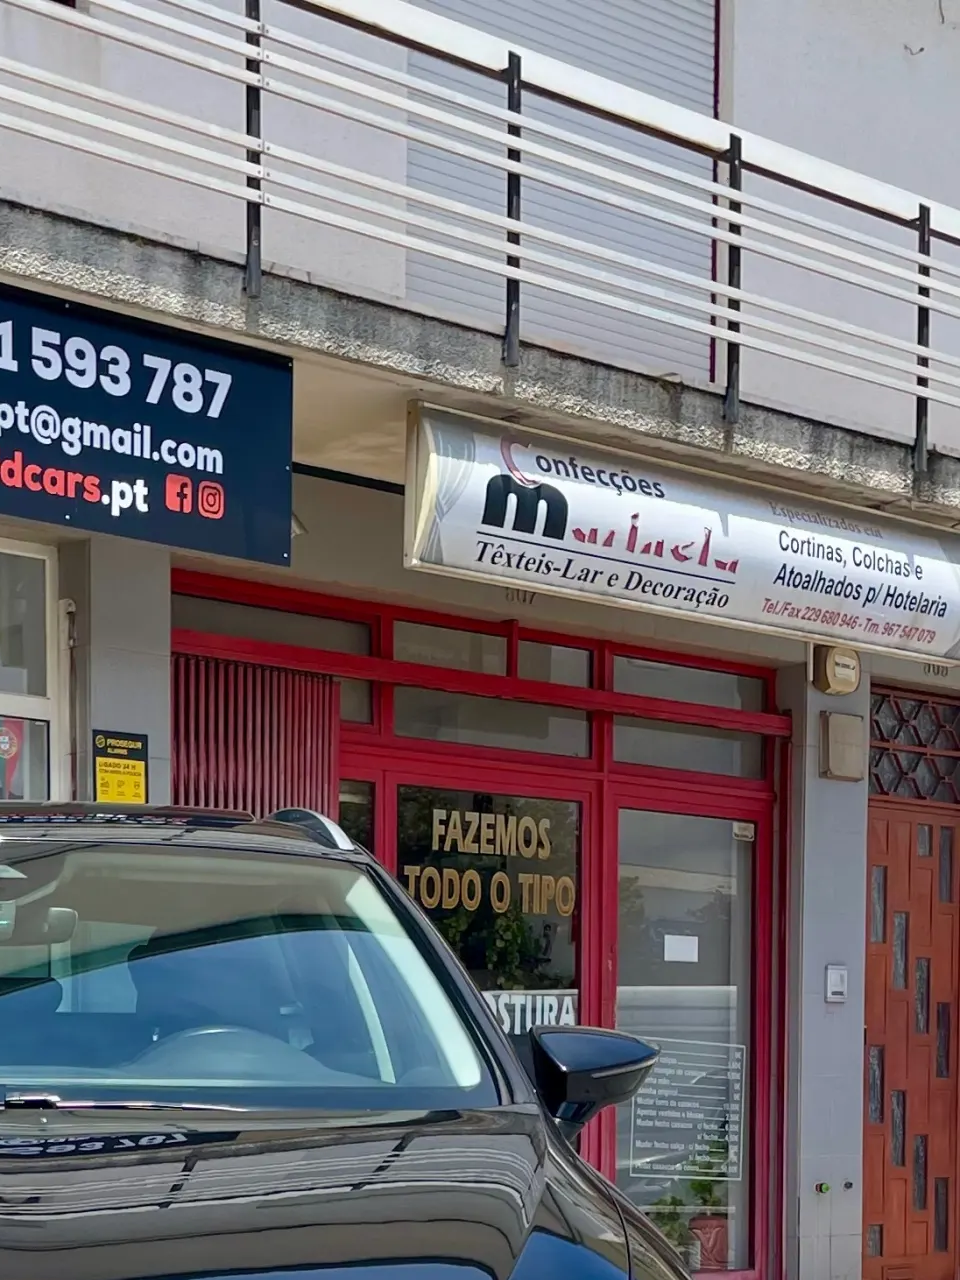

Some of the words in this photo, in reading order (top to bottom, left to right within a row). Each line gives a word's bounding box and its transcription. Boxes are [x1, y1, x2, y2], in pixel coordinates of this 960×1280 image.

[31, 326, 131, 397] 593
[143, 354, 232, 419] 787
[474, 540, 604, 584] Têxteis-Lar
[607, 573, 620, 588] e
[623, 570, 730, 608] Decoração
[778, 530, 847, 568] Cortinas,
[852, 546, 911, 578] Colchas
[914, 564, 924, 580] e
[773, 563, 863, 601] Atoalhados
[862, 583, 884, 608] p/
[882, 584, 948, 618] Hotelaria
[801, 605, 823, 623] 229
[820, 609, 842, 626] 680
[840, 613, 859, 630] 946
[882, 620, 901, 637] 967
[899, 624, 919, 641] 547
[917, 628, 936, 645] 079
[432, 809, 552, 860] FAZEMOS
[404, 865, 482, 911] TODO
[490, 871, 511, 913] O
[518, 873, 576, 917] TIPO
[486, 993, 576, 1035] STURA
